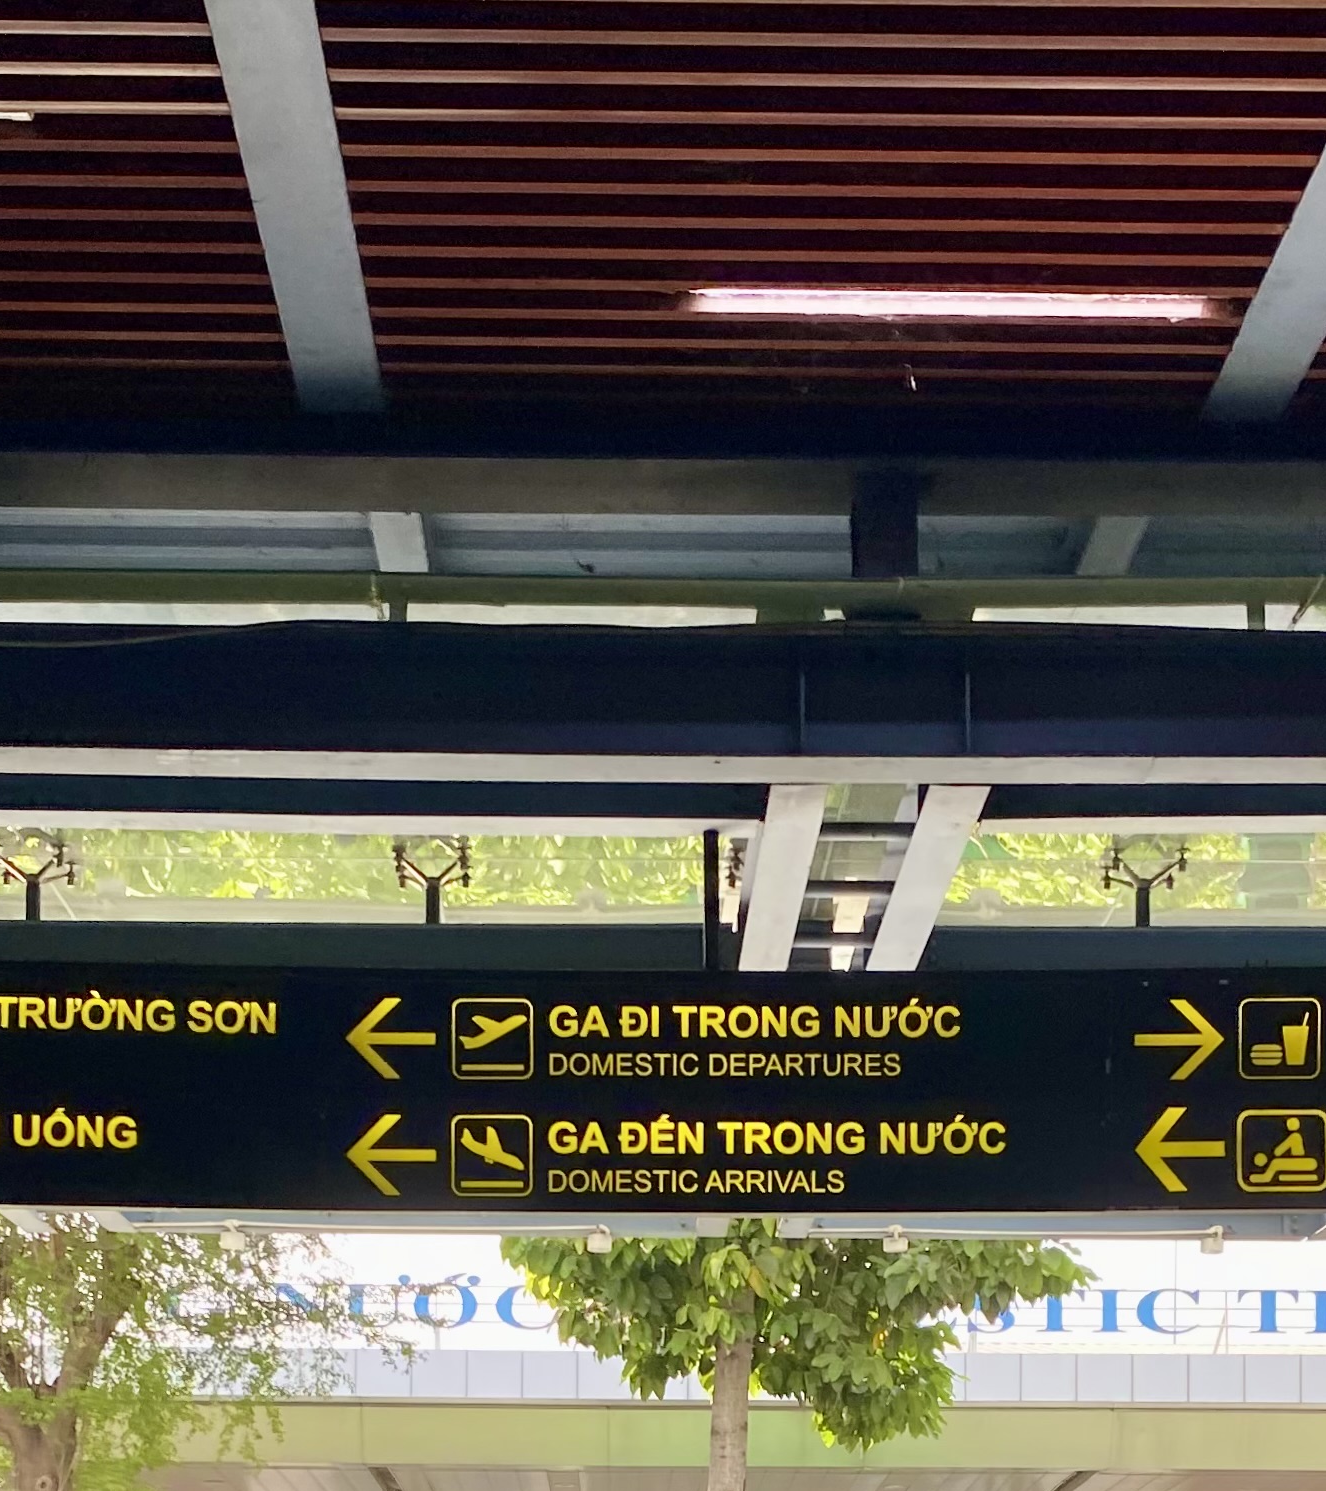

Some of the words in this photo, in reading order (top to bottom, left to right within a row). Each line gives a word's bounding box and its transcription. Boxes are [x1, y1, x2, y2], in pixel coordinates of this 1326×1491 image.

[187, 1000, 277, 1034] SƠN
[548, 1005, 610, 1038] GA
[618, 1005, 660, 1038] ĐI
[671, 1005, 821, 1039] TRONG
[835, 998, 961, 1038] NƯỚC
[548, 1053, 699, 1077] DOMESTIC
[707, 1053, 901, 1077] DEPARTURES
[12, 1107, 138, 1150] UỐNG
[547, 1121, 610, 1155] GA
[617, 1115, 705, 1155] ĐẾN
[716, 1121, 866, 1156] TRONG
[879, 1115, 1007, 1155] NƯỚC
[548, 1169, 699, 1194] DOMESTIC
[705, 1169, 845, 1194] ARRIVALS
